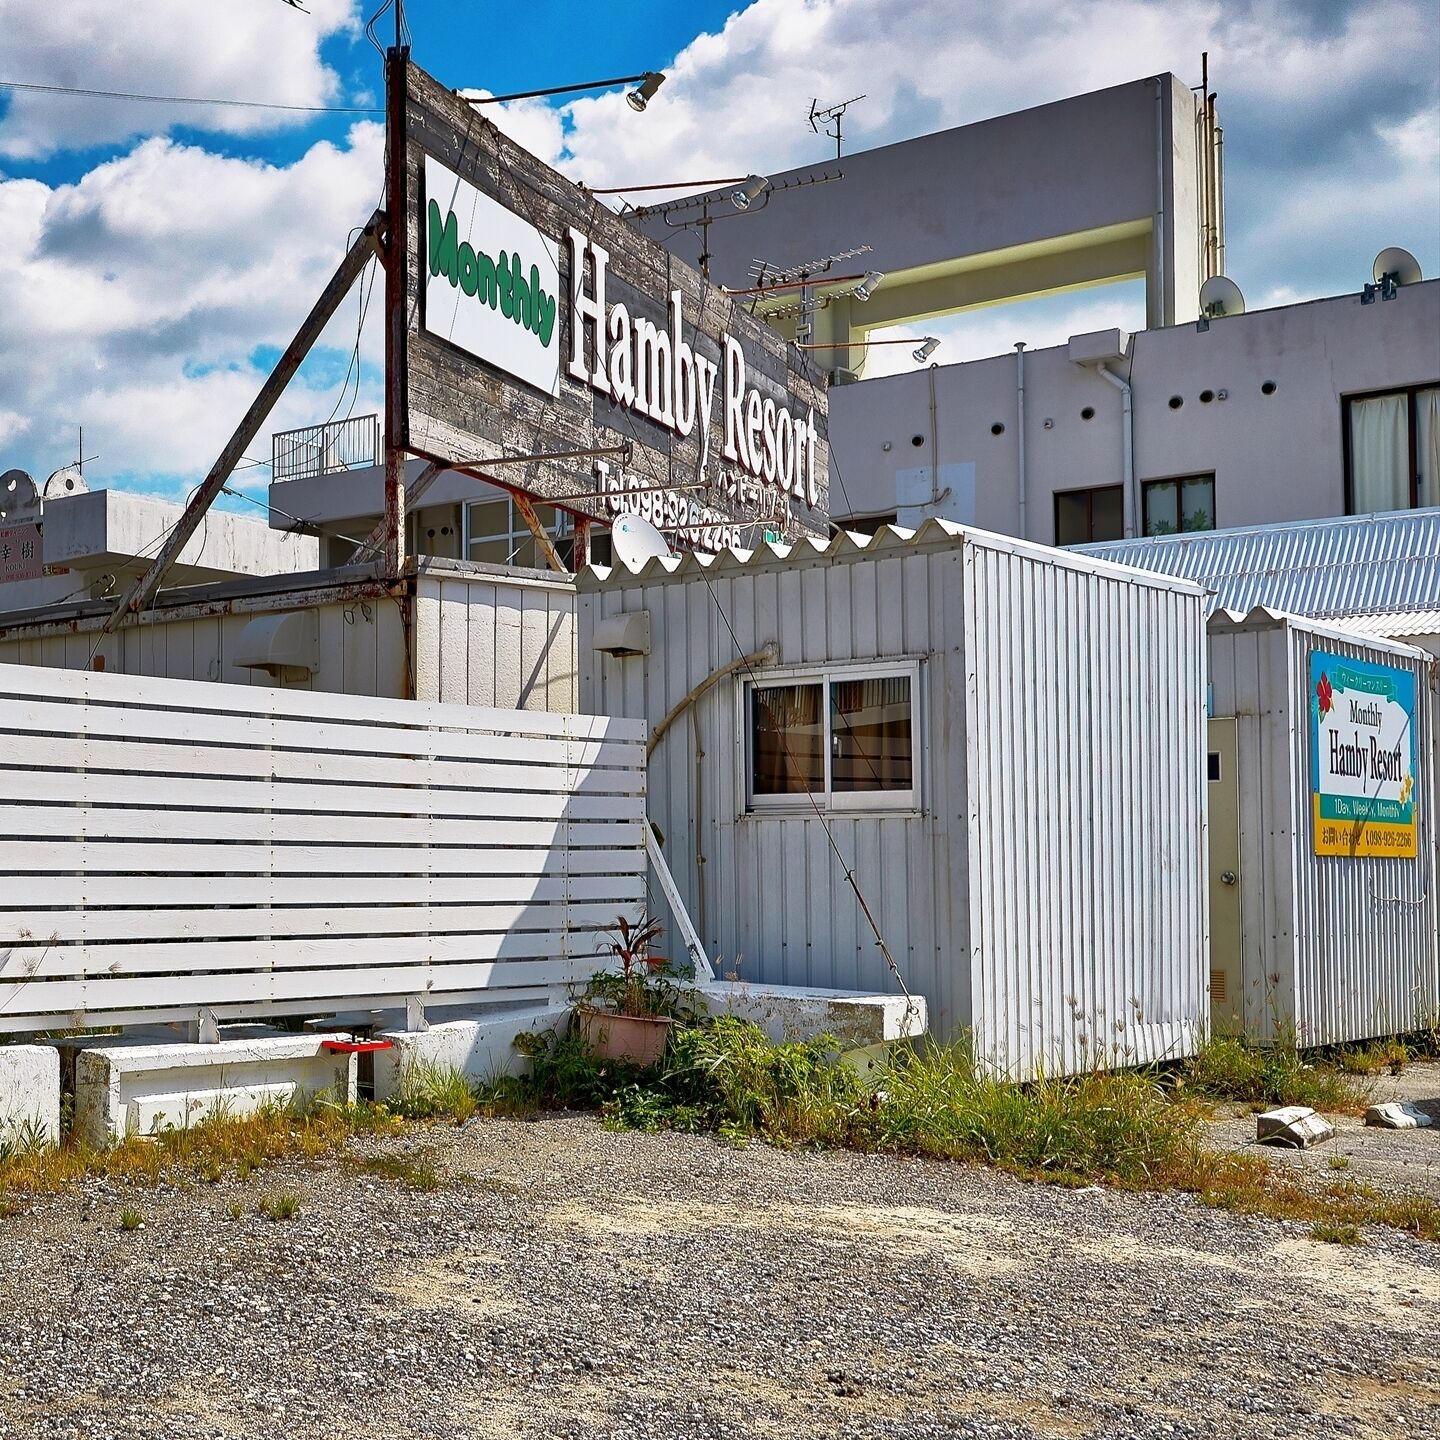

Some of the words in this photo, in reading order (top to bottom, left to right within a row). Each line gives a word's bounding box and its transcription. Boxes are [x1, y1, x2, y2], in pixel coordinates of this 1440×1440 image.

[428, 198, 556, 348] Monthly
[567, 225, 717, 482] Hamby
[722, 332, 818, 507] Resort
[1349, 699, 1383, 735] Monthly
[1329, 728, 1368, 794] Hamby
[1369, 735, 1402, 782] Resort
[1377, 802, 1400, 818] Monthly
[1322, 826, 1360, 846] お問い合わせ
[1369, 830, 1412, 847] 098-926-2266
